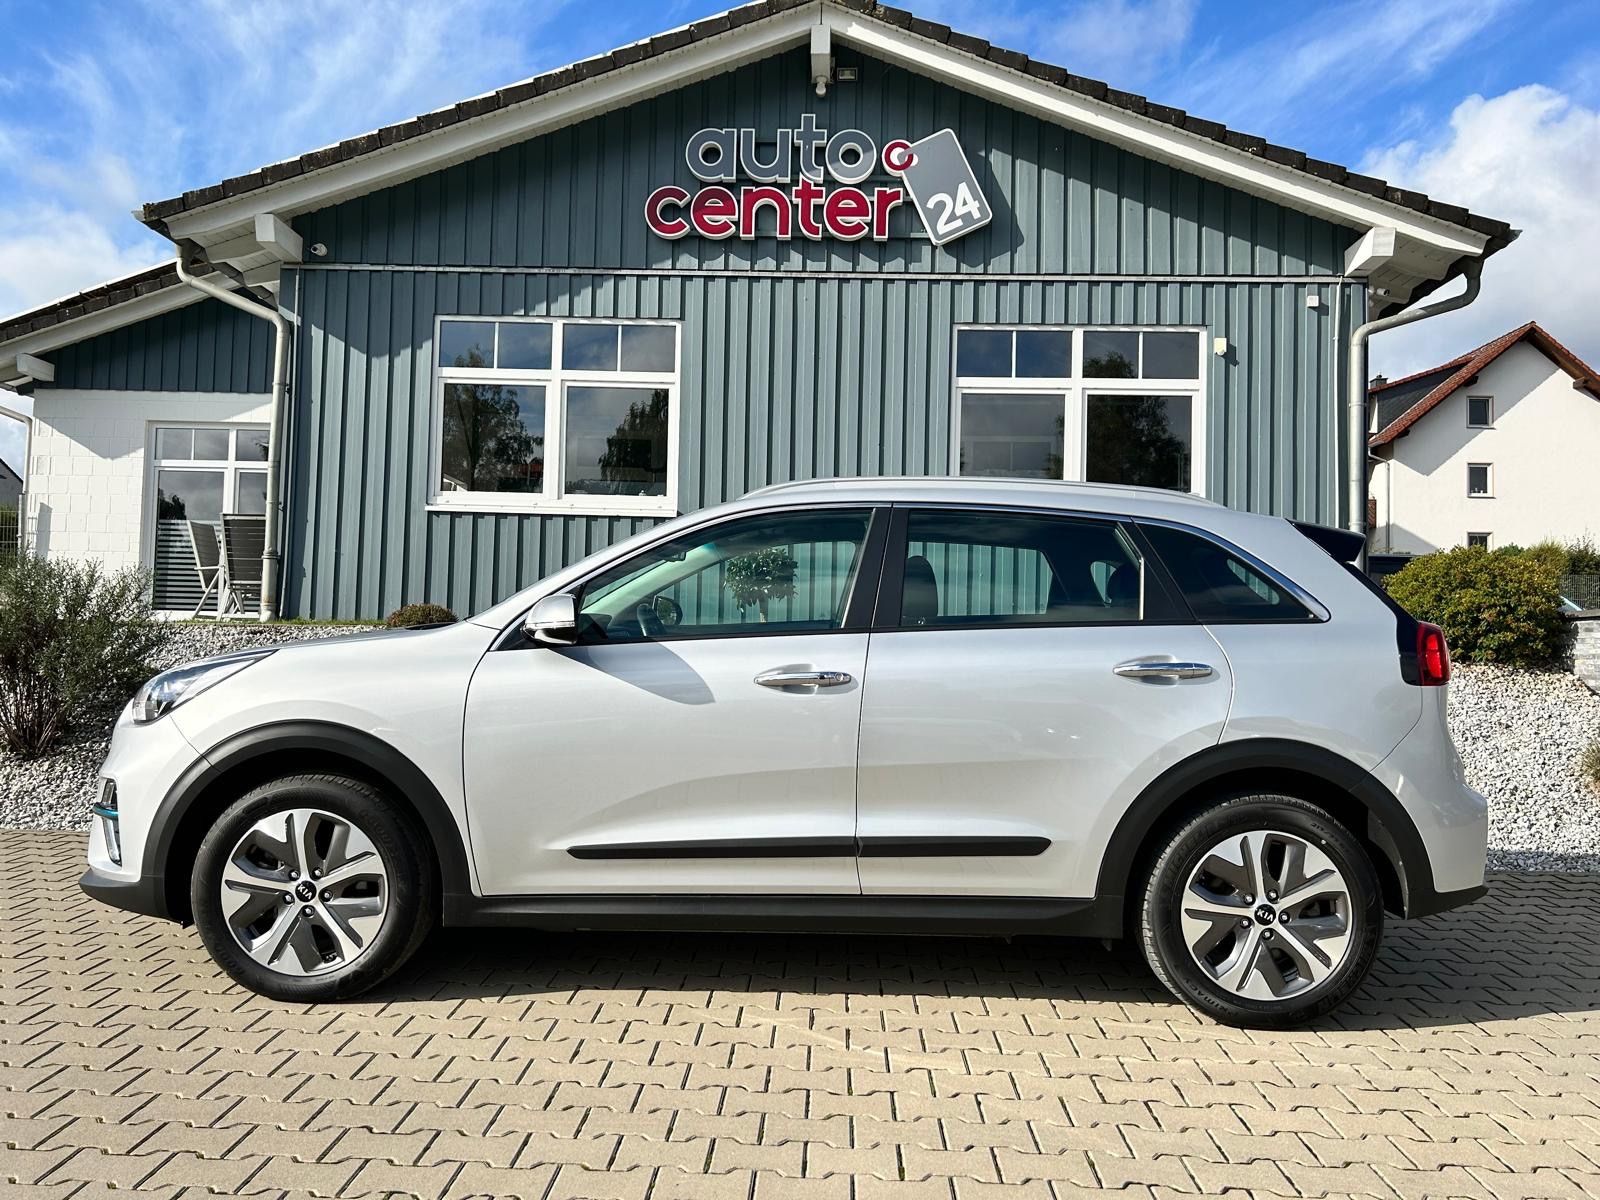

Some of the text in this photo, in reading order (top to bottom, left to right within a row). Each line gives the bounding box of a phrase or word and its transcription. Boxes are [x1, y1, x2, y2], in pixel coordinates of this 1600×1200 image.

[686, 113, 877, 184] auto
[645, 174, 903, 241] center
[926, 182, 981, 235] 24
[297, 884, 313, 900] KIA
[1257, 908, 1275, 922] KIA
